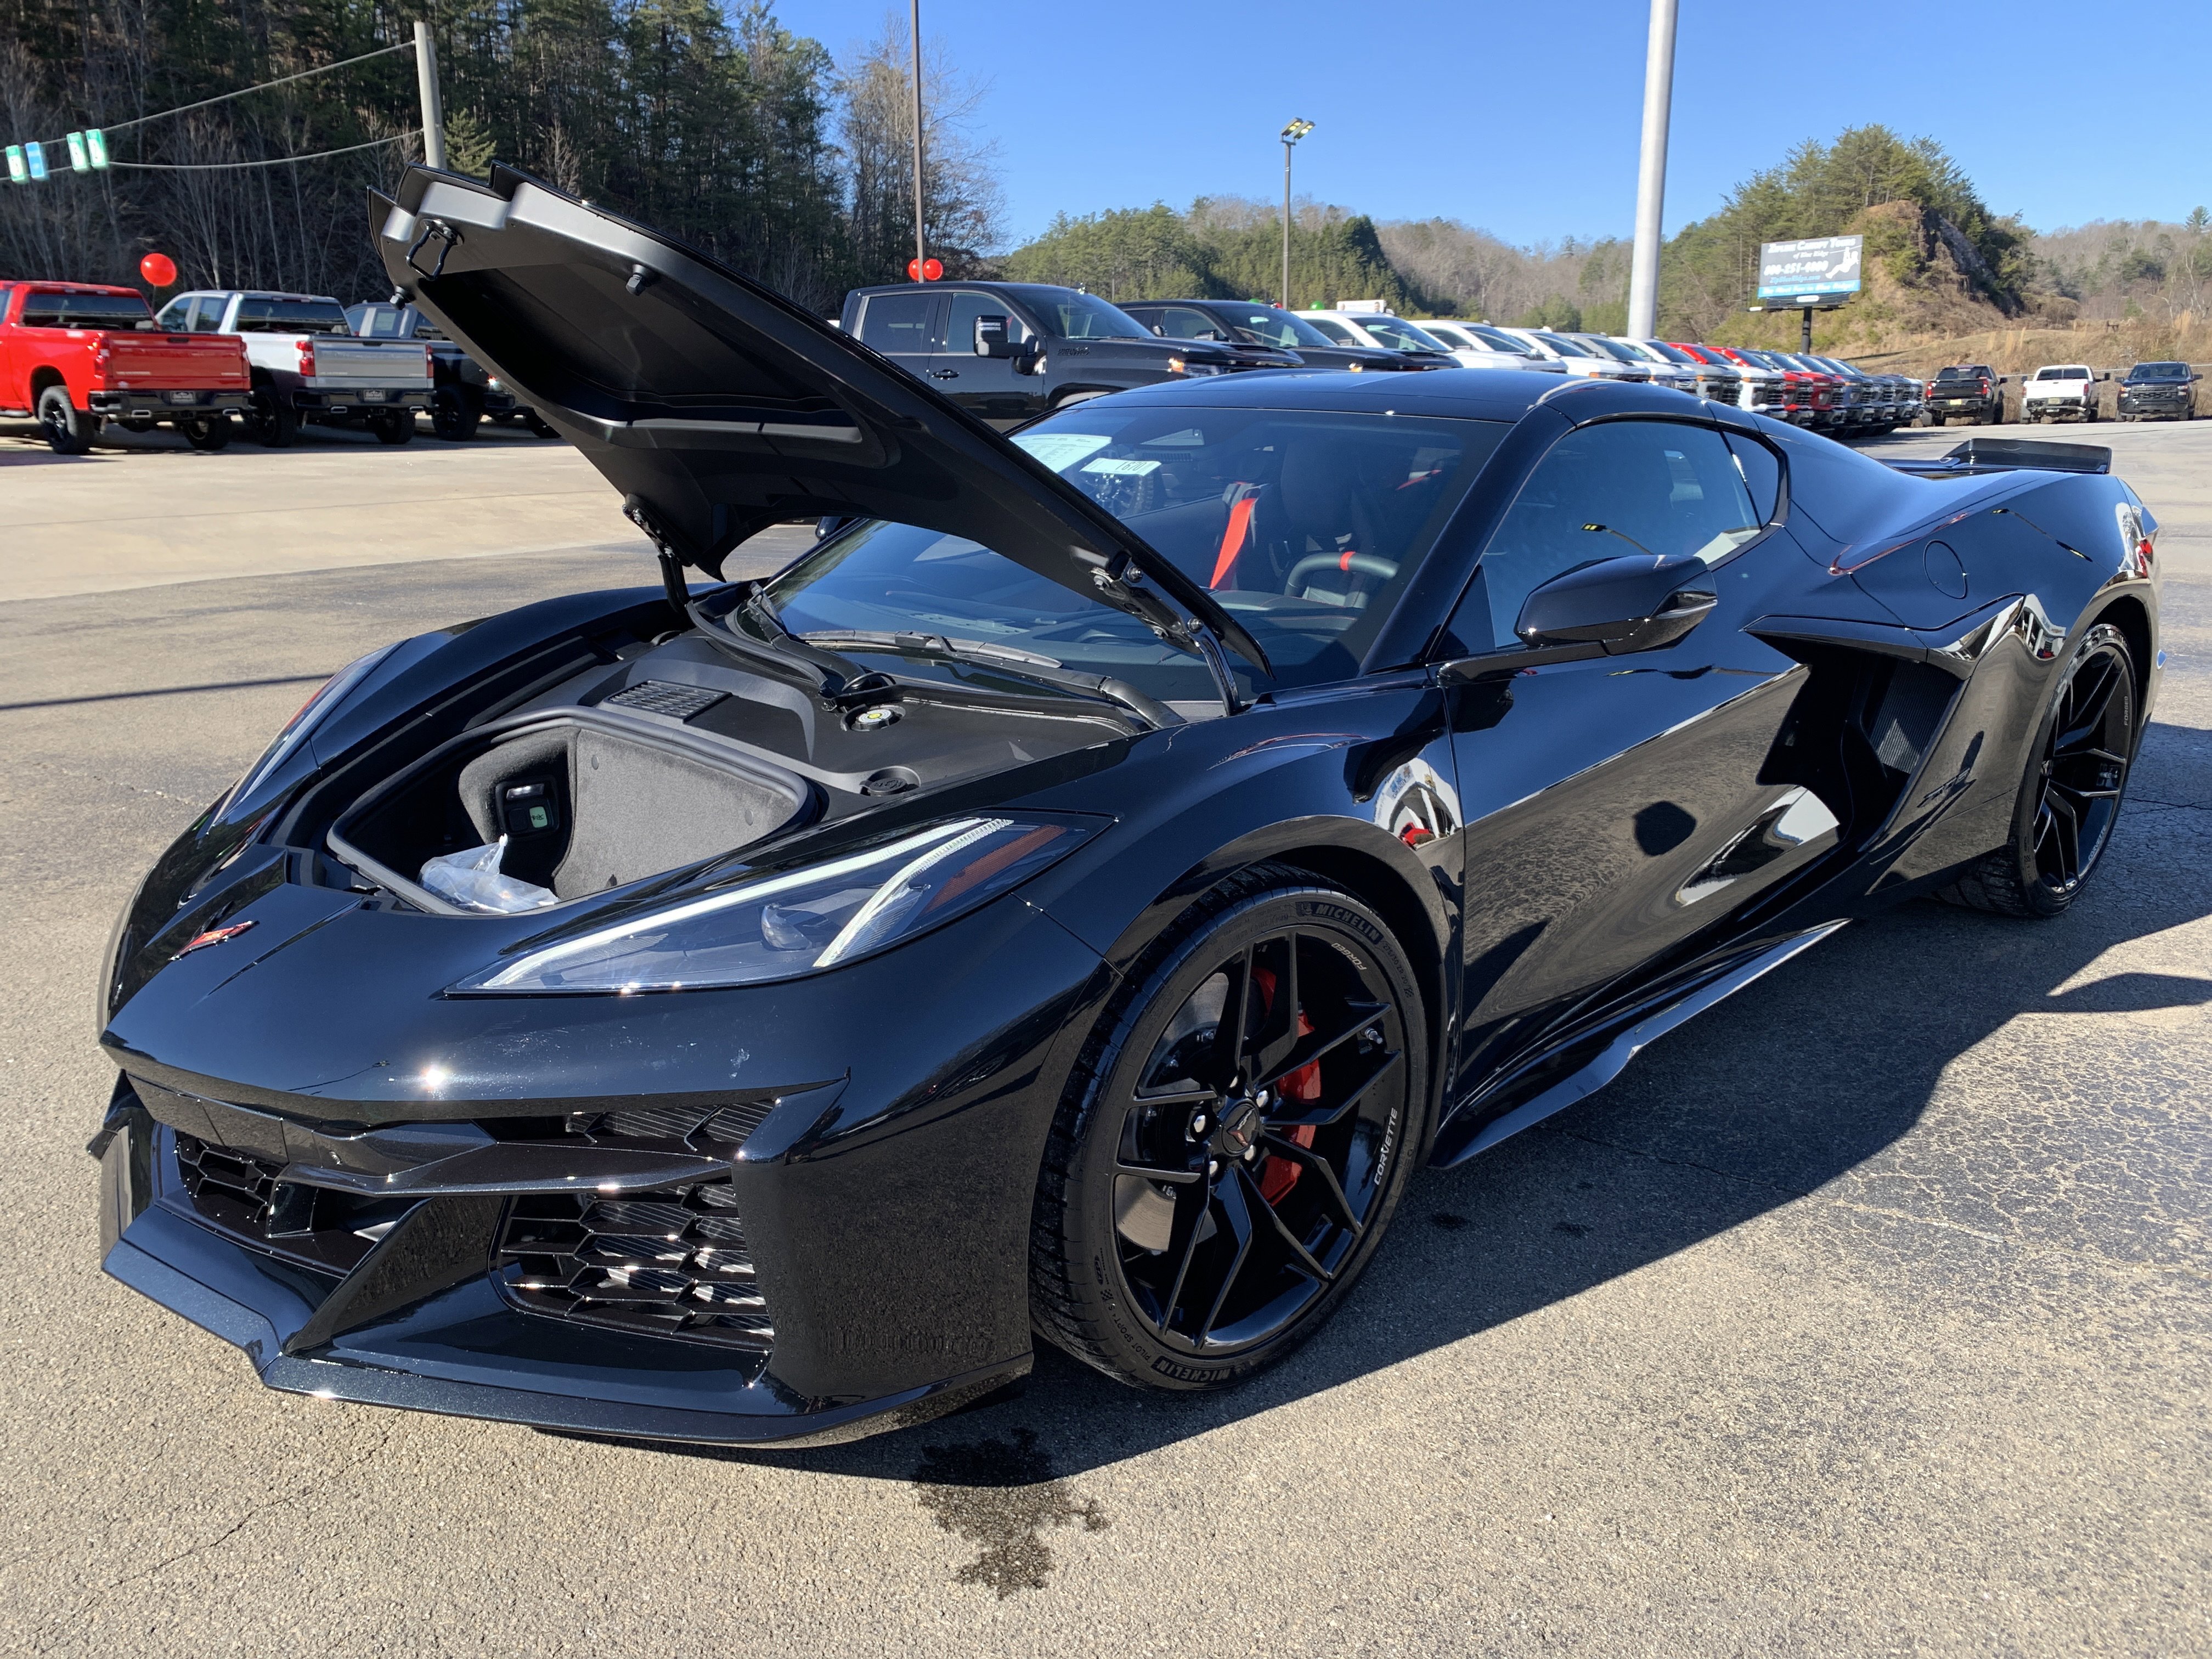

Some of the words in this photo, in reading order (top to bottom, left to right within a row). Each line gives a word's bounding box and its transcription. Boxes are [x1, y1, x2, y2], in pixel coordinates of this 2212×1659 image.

[1315, 904, 1380, 941] MICHELIN
[1331, 943, 1367, 970] FORGED
[1374, 1107, 1398, 1186] CORVETTE
[1114, 1318, 1134, 1342] SPORT
[1131, 1342, 1152, 1361] PILOT
[1156, 1359, 1231, 1381] MICHELIN
